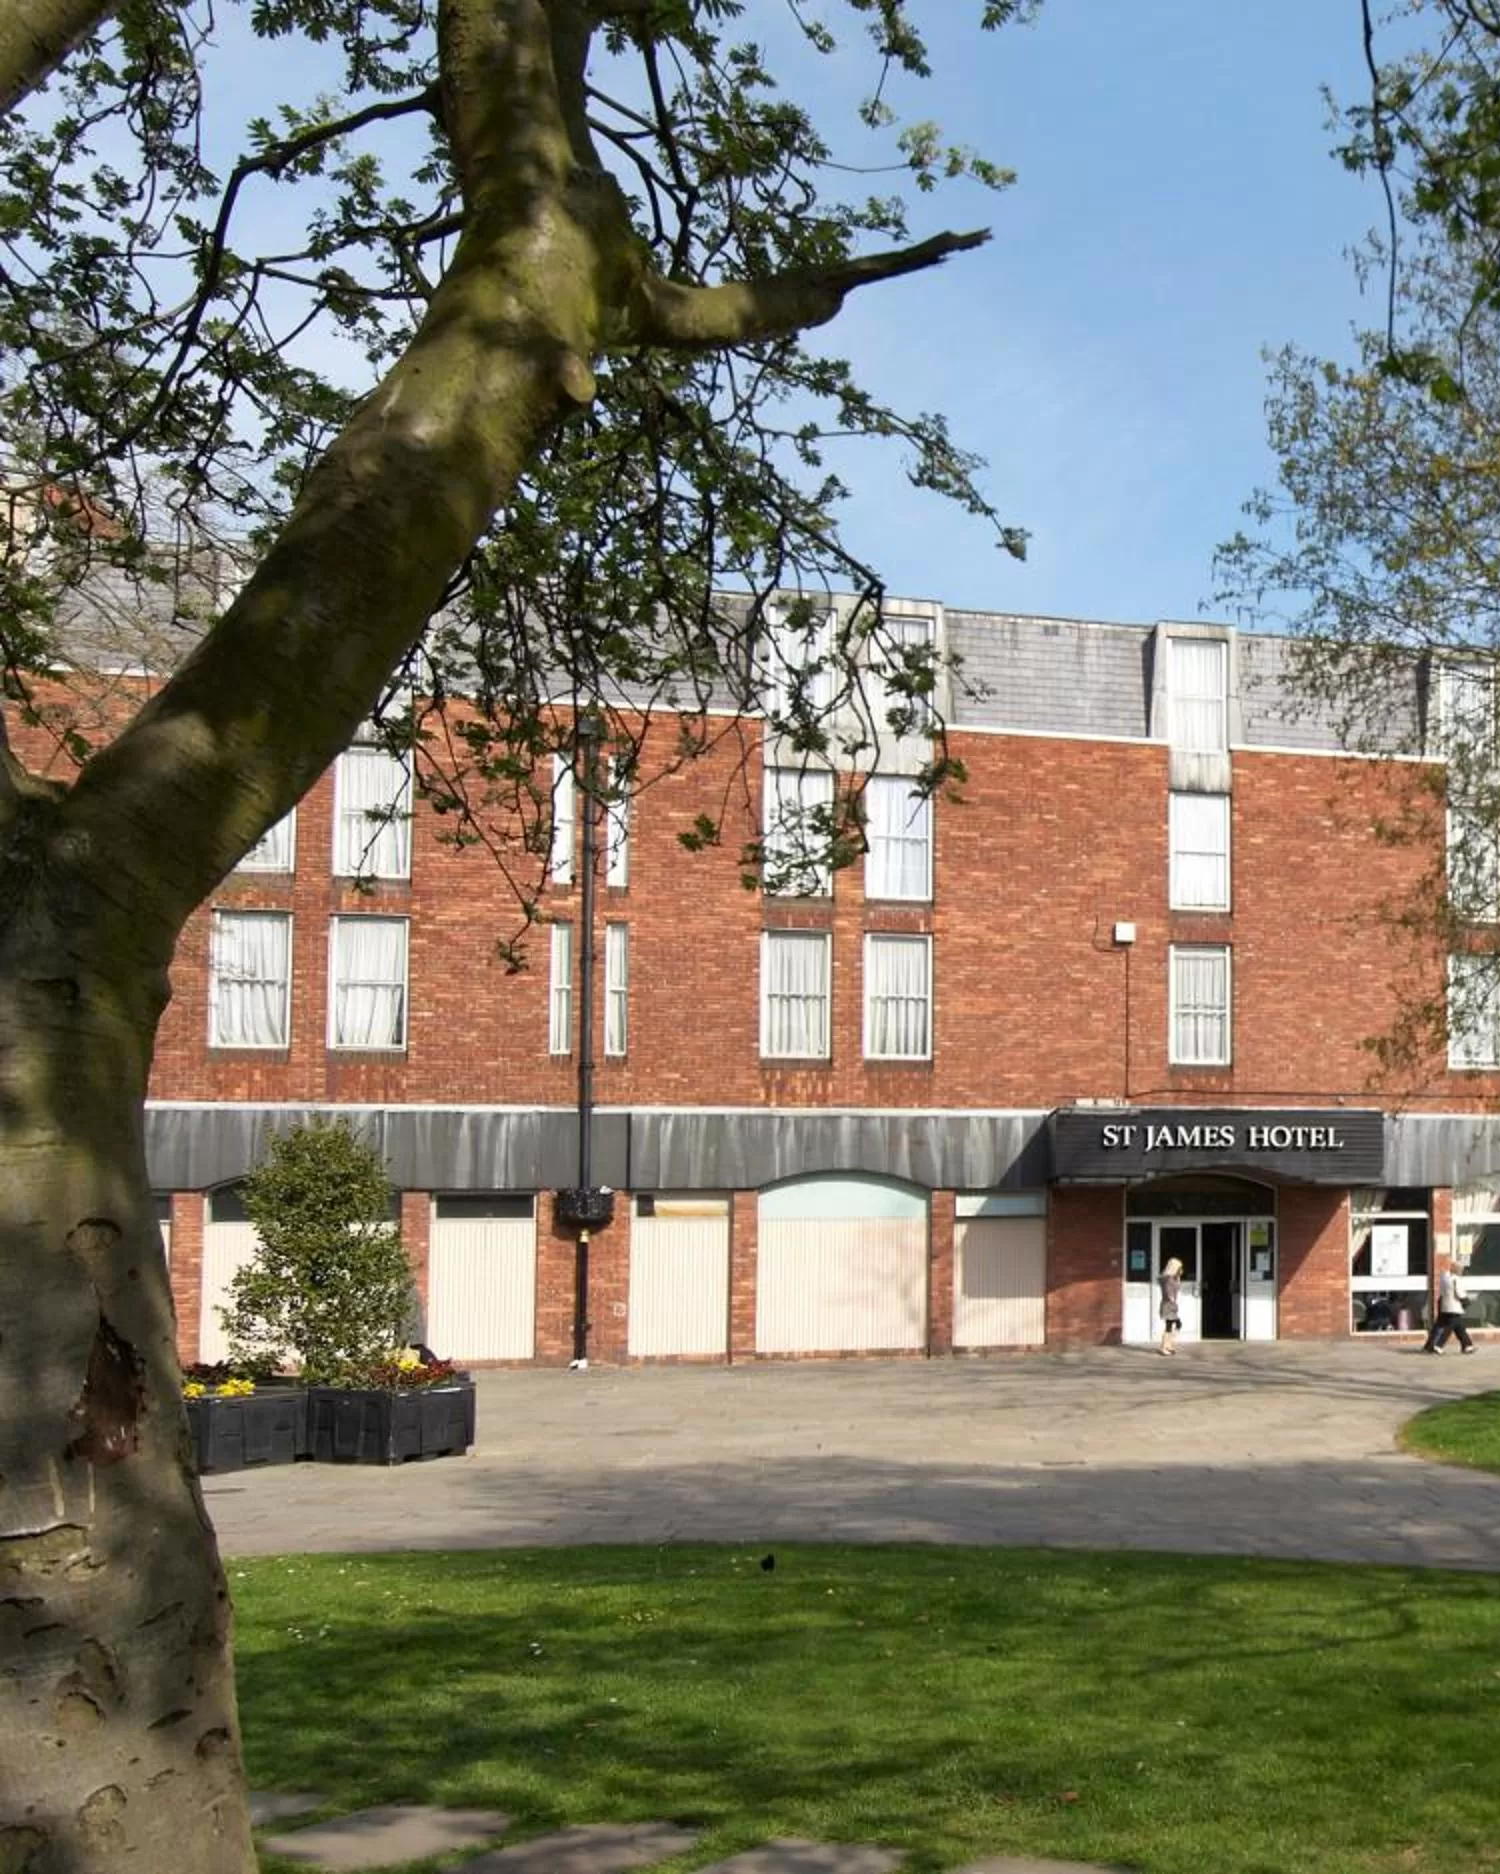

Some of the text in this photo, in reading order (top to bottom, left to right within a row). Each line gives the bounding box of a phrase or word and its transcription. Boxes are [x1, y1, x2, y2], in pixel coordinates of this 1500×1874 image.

[1102, 1124, 1345, 1151] ST JAMES HOTEL
